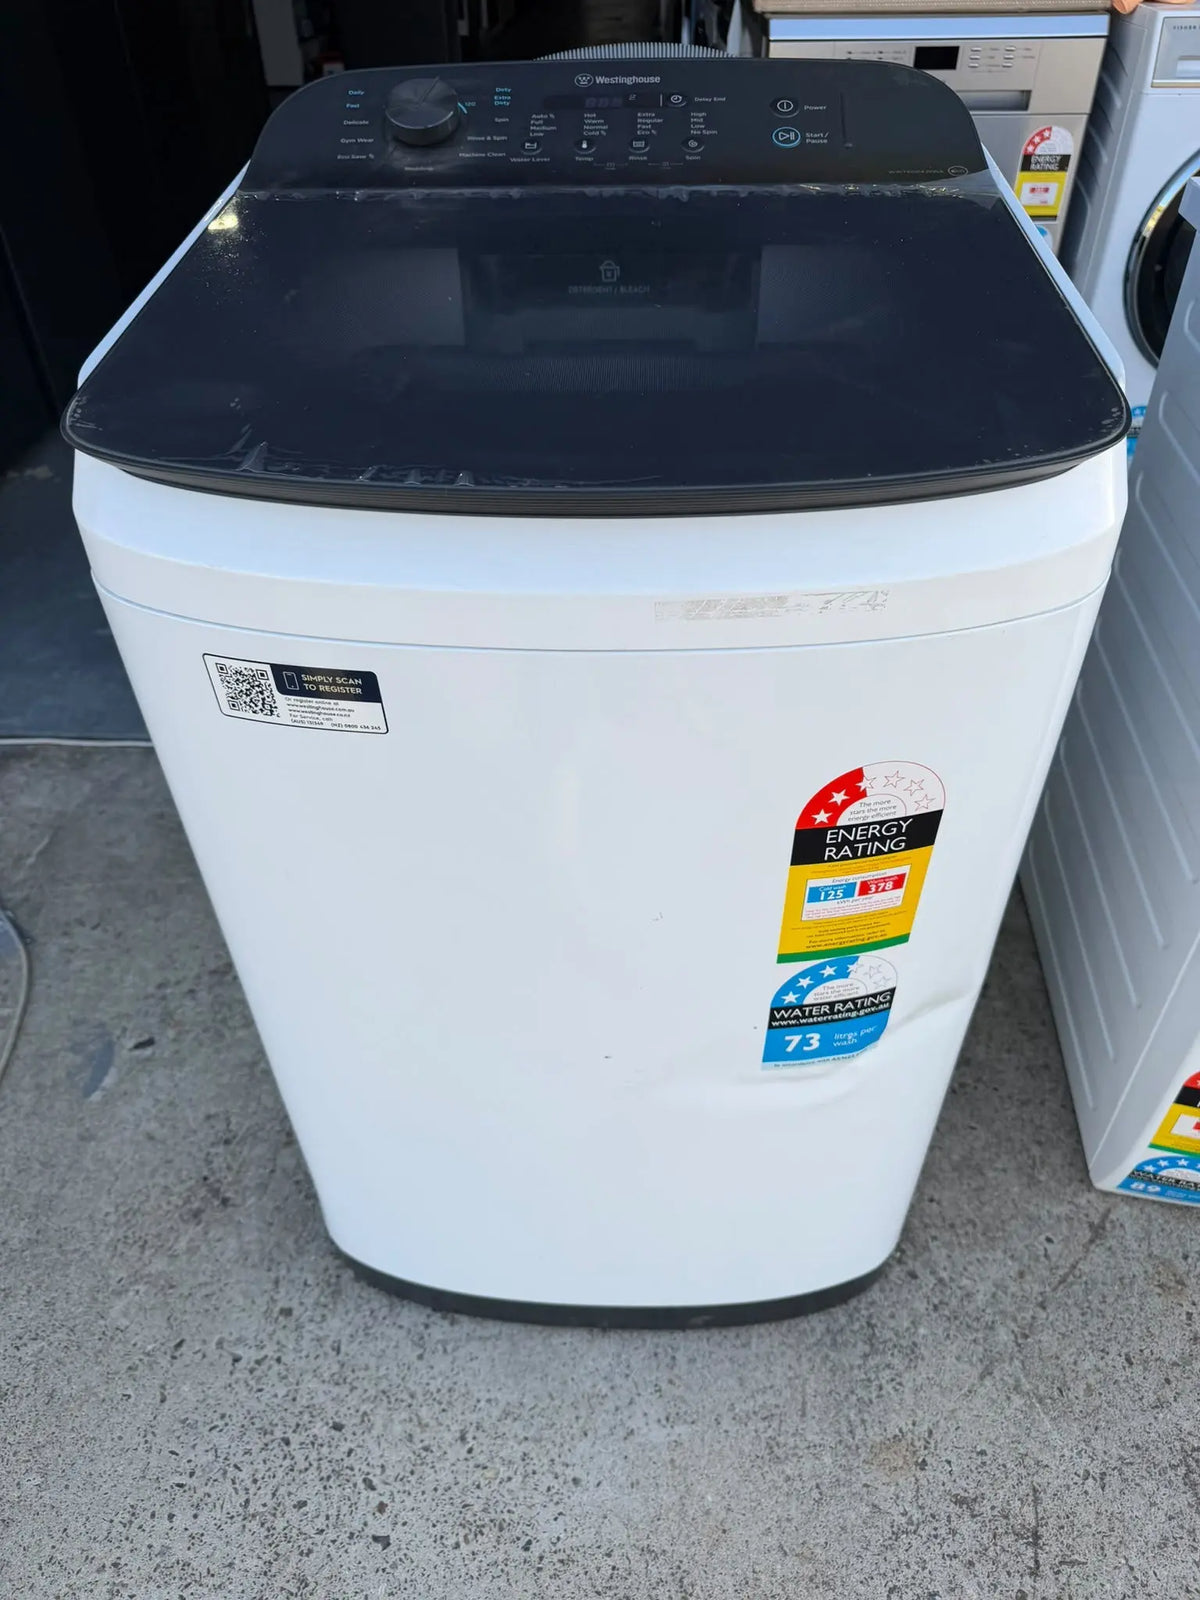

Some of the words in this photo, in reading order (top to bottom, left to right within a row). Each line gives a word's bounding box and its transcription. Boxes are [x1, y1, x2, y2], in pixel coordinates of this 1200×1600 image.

[595, 75, 661, 85] Westinghouse
[301, 674, 333, 684] SIMPLY
[336, 676, 362, 686] SCAN
[303, 683, 317, 691] TO
[319, 684, 362, 695] REGISTER
[287, 703, 355, 713] www.westinghouse.com.au
[288, 709, 351, 718] www.westinghouse.co.nz
[848, 814, 870, 822] energy
[871, 811, 897, 819] efficient
[850, 808, 867, 816] stars
[867, 806, 878, 814] the
[826, 818, 913, 844] ENERGY
[824, 837, 907, 861] RATING
[832, 876, 851, 884] Energy
[852, 871, 887, 881] consumption
[868, 881, 894, 894] 378
[820, 890, 844, 901] 125
[806, 933, 888, 949] www.energyrating.gov.au
[773, 1005, 830, 1019] WATER
[834, 991, 892, 1014] RATING
[771, 1002, 890, 1027] www.waterrating.gov.au
[834, 1032, 858, 1040] litres
[860, 1025, 879, 1036] per
[784, 1033, 821, 1053] 73
[832, 1038, 858, 1047] wash
